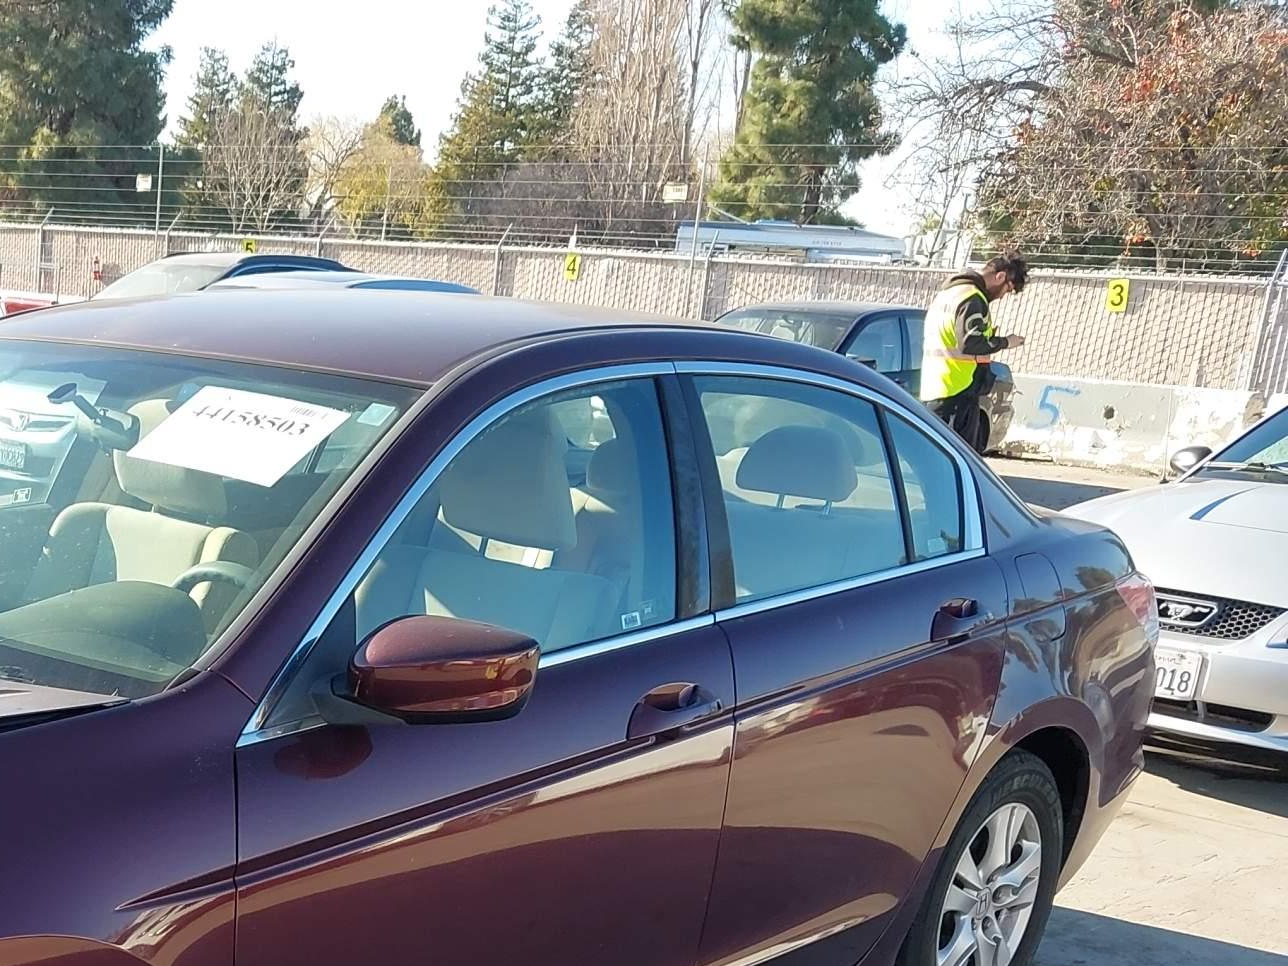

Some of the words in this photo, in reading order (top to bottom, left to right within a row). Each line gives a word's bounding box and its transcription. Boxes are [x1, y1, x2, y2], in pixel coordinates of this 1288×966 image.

[566, 255, 577, 275] 4
[1110, 284, 1124, 307] 3
[192, 405, 311, 436] 44158503
[1026, 385, 1081, 430] 5
